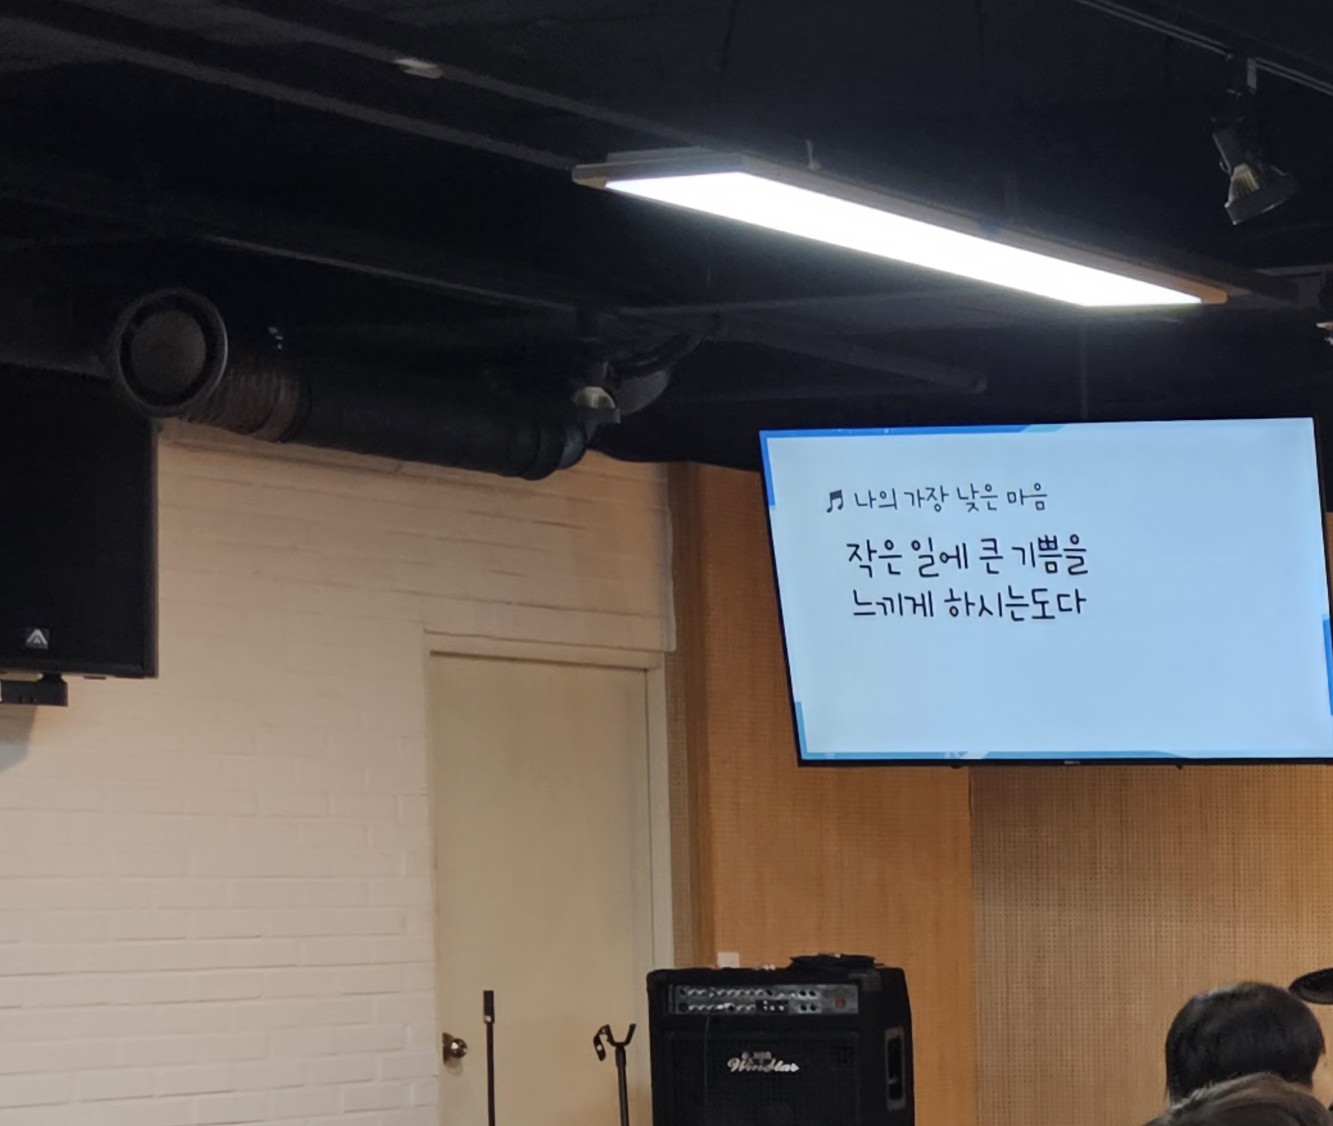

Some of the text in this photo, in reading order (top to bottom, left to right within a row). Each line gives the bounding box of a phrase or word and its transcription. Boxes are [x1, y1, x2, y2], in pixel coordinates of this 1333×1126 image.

[854, 482, 1048, 513] 나의 가장 낮은 마음
[846, 533, 1089, 579] 작은 일에 큰 기쁨을
[852, 584, 1087, 622] 느끼게 하시는도다
